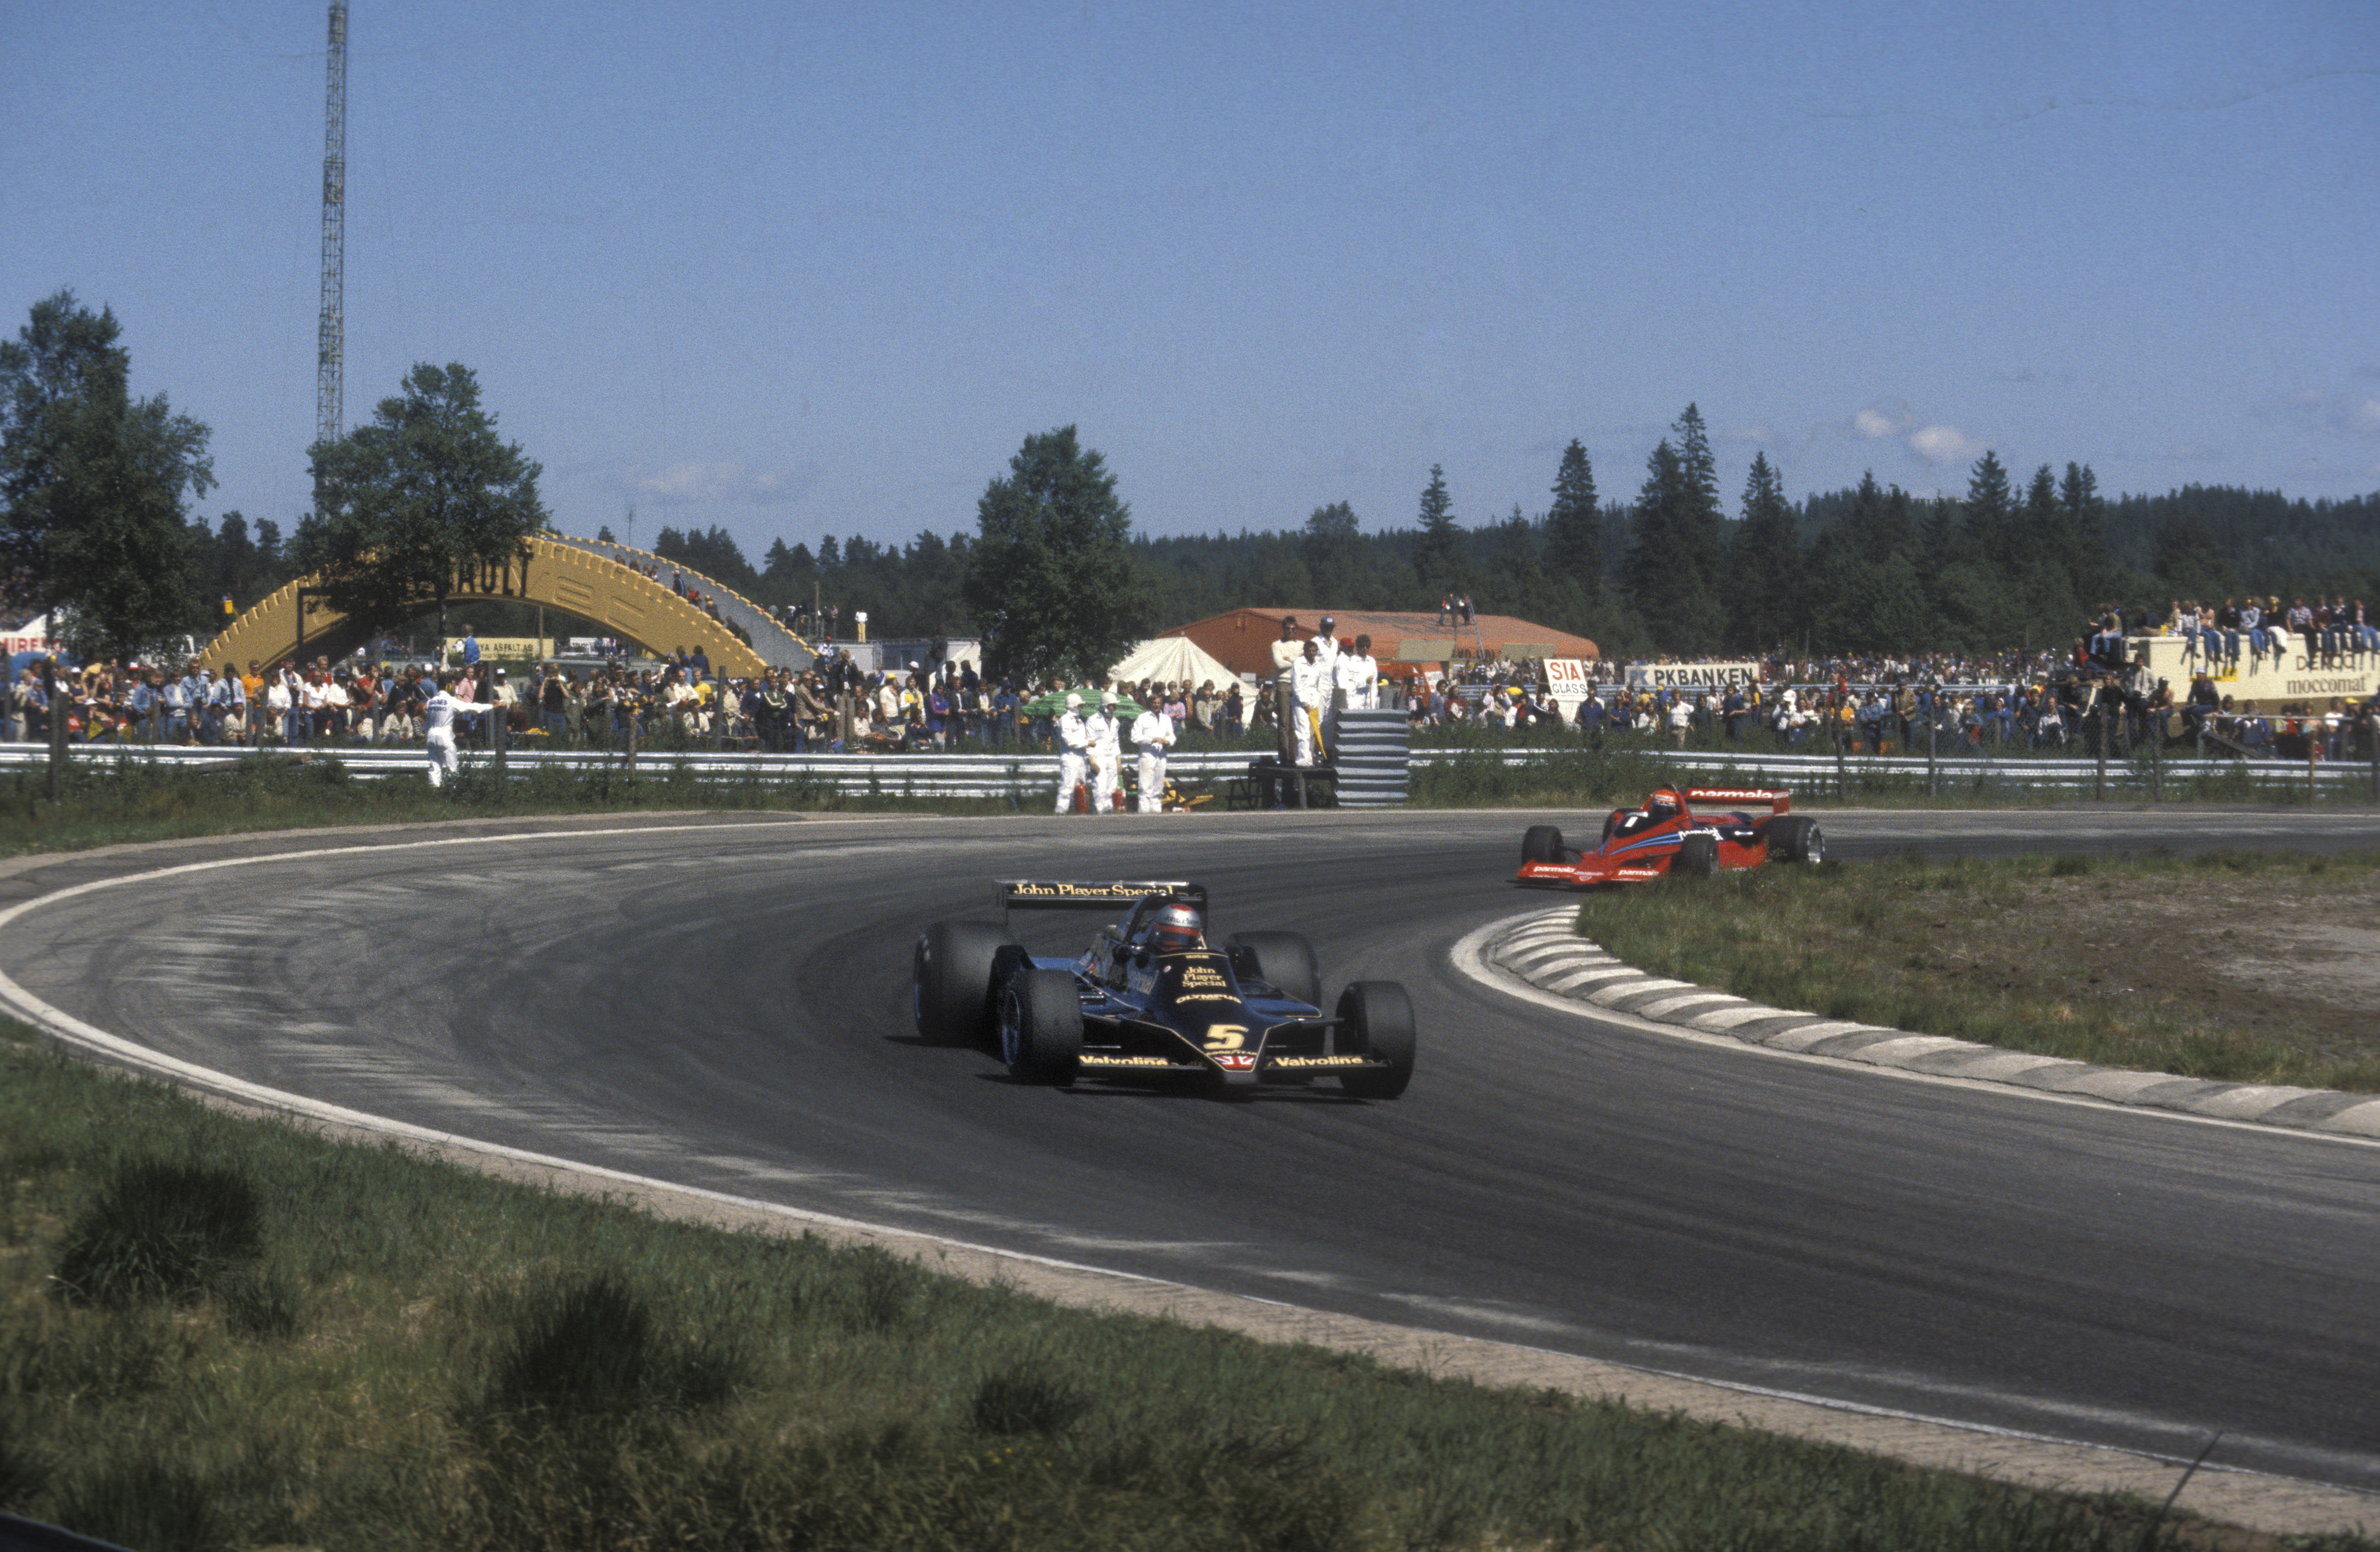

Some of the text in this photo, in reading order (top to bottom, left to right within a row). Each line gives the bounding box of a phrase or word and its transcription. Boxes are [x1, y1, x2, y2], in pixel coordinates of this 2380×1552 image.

[1549, 662, 1581, 681] SIA
[1654, 668, 1754, 685] PKBANKEN
[2286, 675, 2366, 694] moccomat
[1014, 884, 1173, 896] John Player Special
[1183, 973, 1222, 981] Player
[1176, 994, 1241, 1003] OLYMPUS
[1203, 1024, 1249, 1049] 5
[1079, 1055, 1168, 1065] Valvoline
[1275, 1056, 1363, 1066] Valvoline
